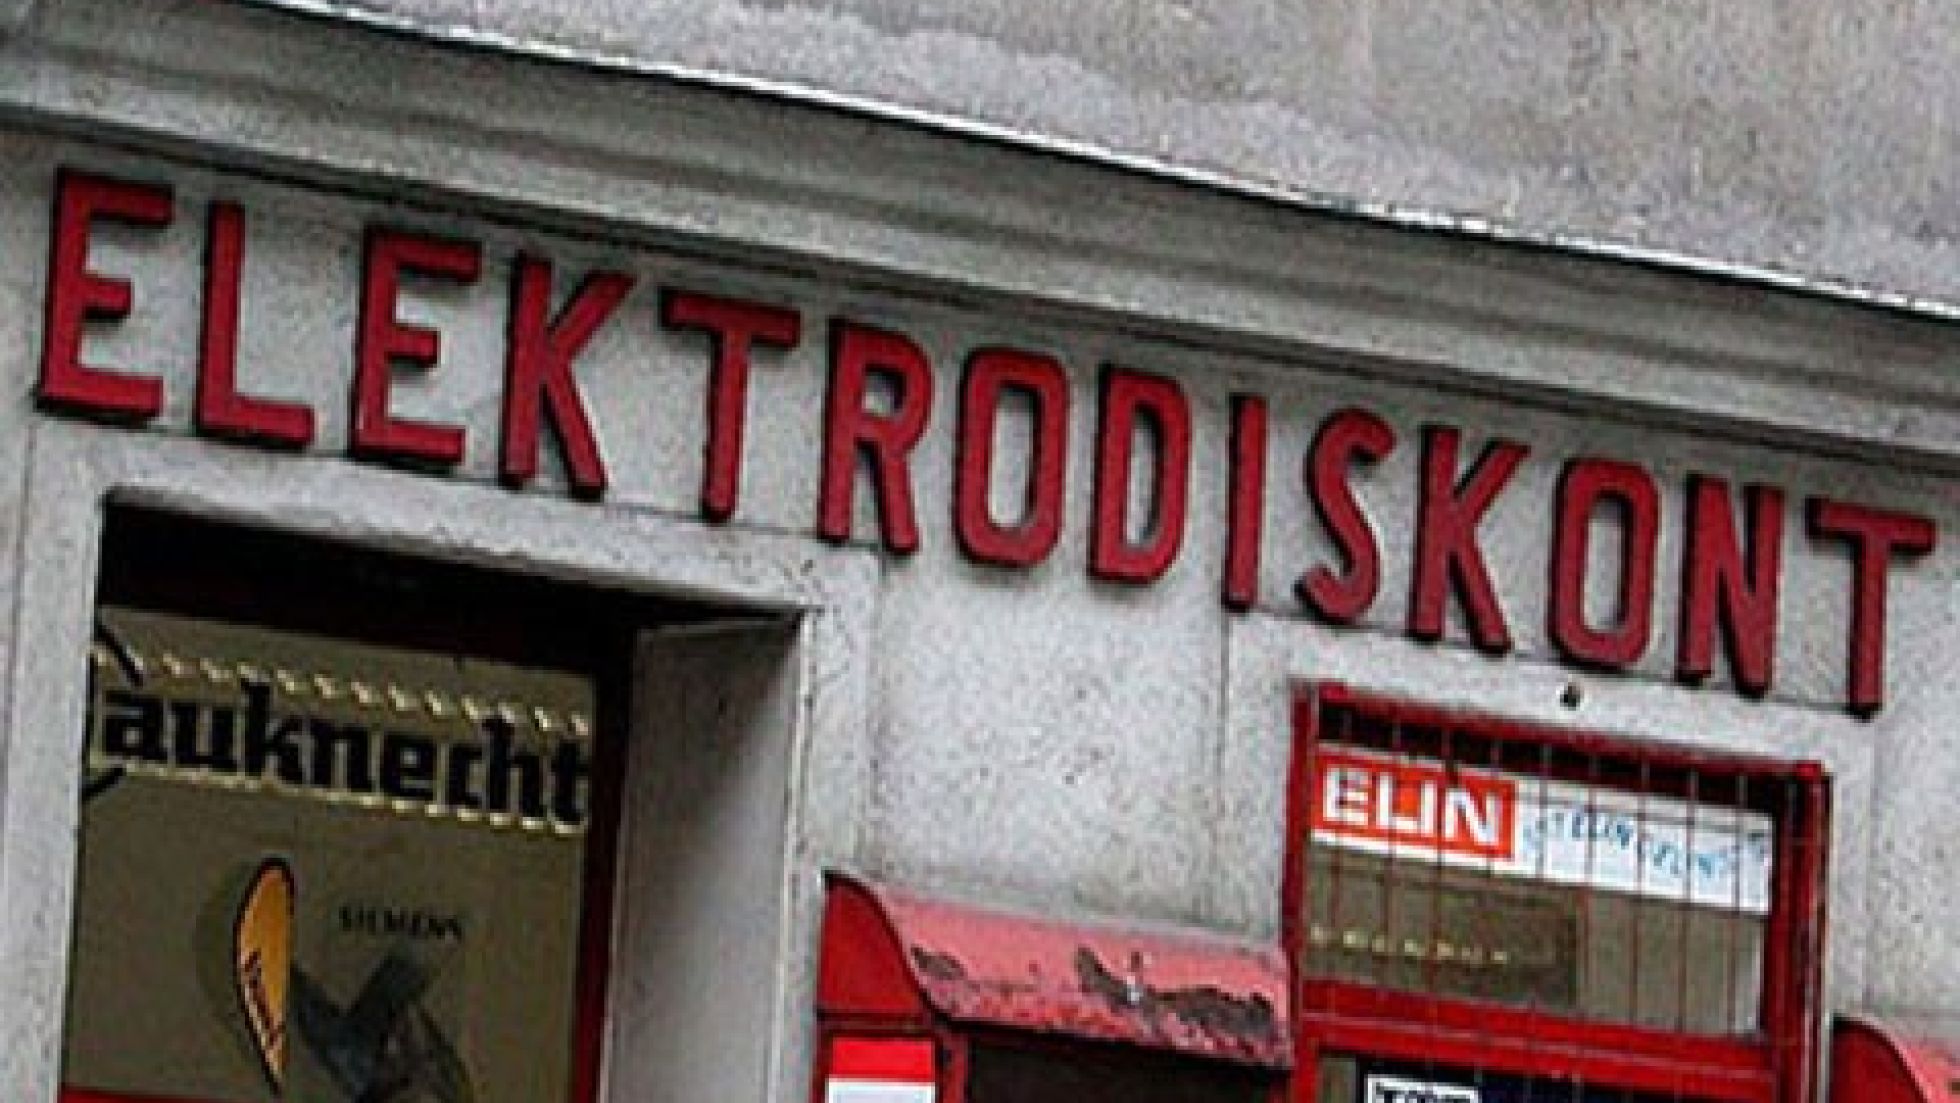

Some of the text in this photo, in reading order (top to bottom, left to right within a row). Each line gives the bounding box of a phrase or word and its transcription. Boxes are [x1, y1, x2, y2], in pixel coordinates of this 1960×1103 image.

[36, 168, 1936, 718] ELEKTRODISKONT
[84, 655, 589, 824] auknecht
[1323, 768, 1500, 846] ELIN
